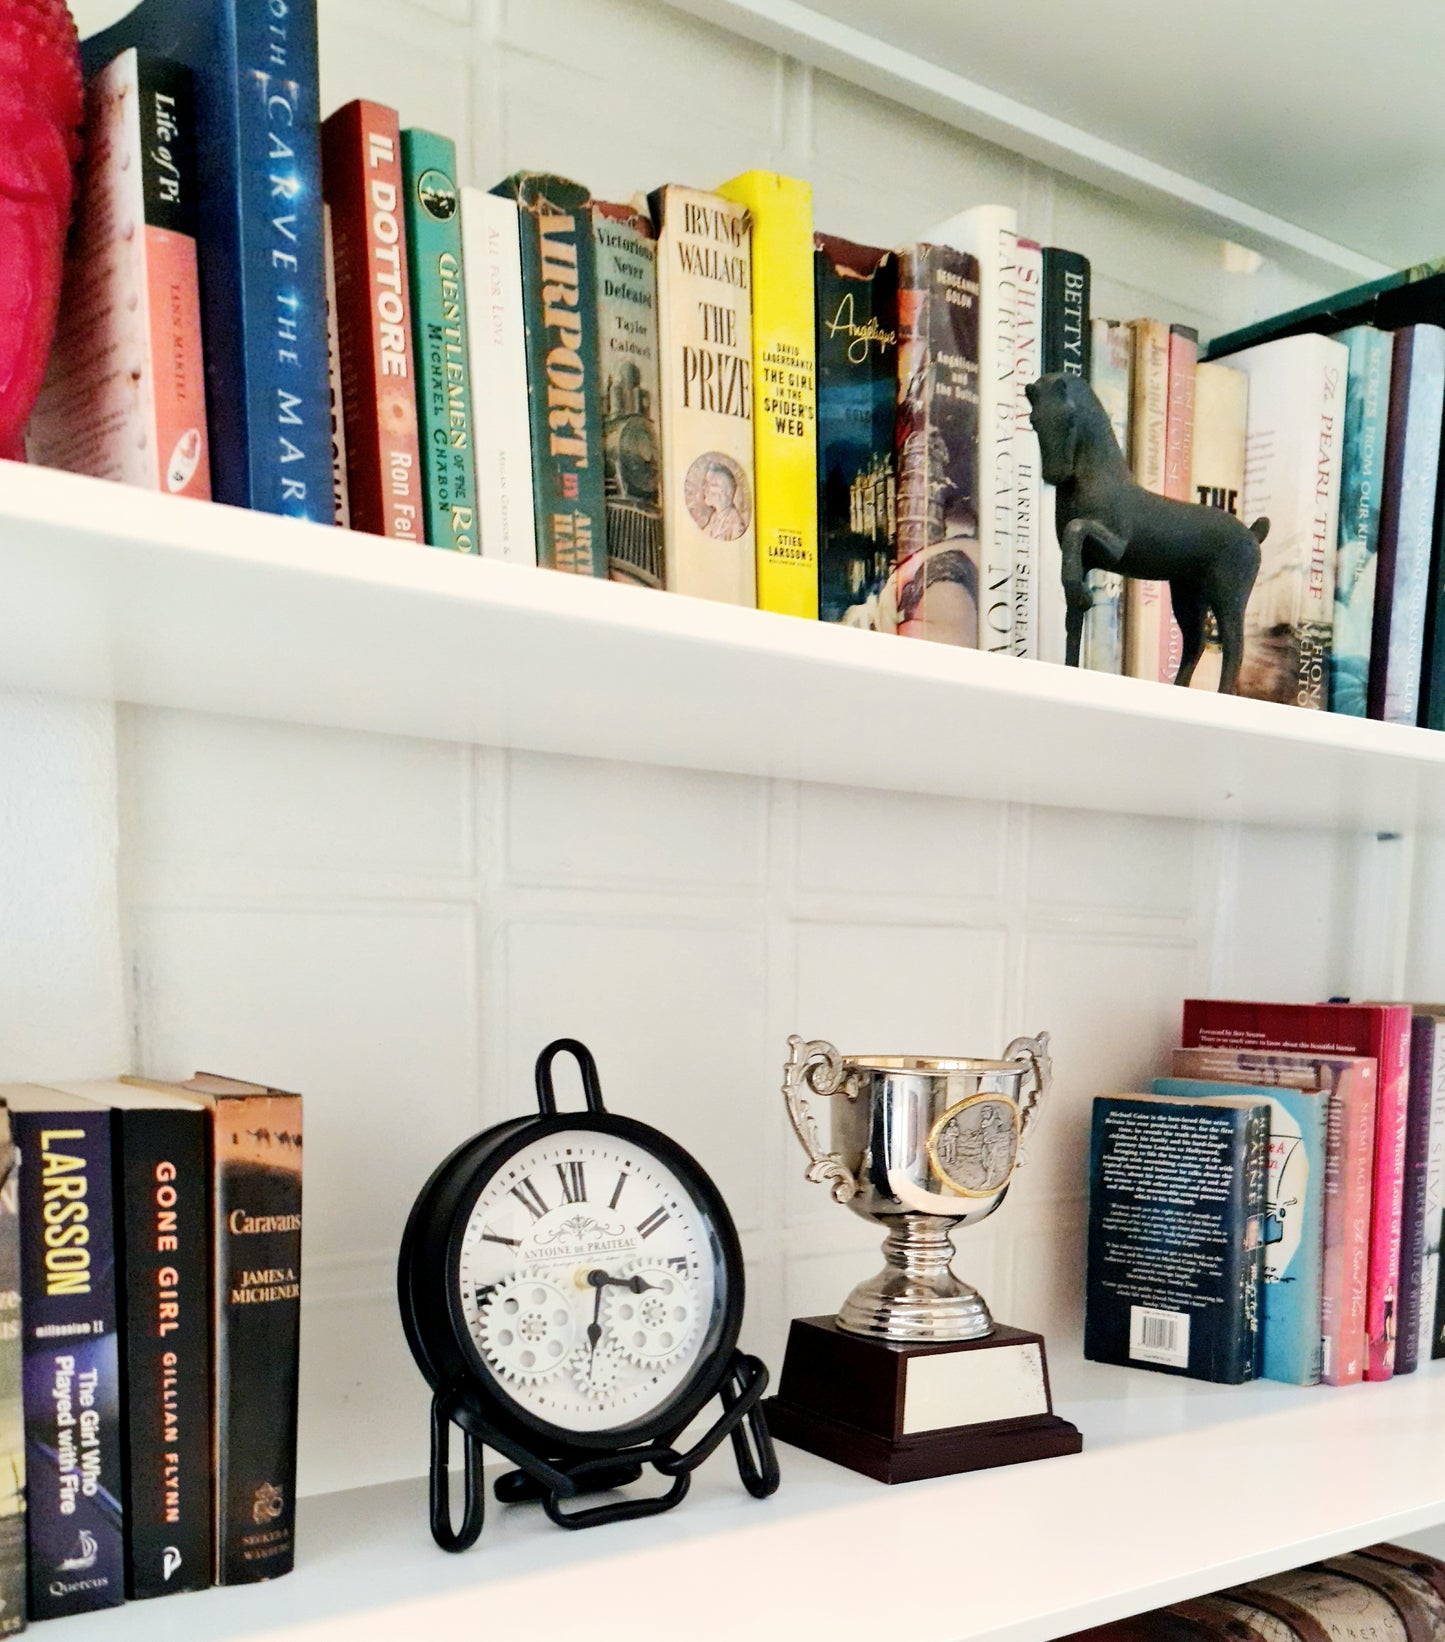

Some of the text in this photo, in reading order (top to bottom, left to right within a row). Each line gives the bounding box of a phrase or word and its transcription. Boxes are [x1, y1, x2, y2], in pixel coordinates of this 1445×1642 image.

[150, 91, 181, 206] Life of Pi
[684, 203, 742, 247] IRVING
[368, 132, 408, 379] IL DOTTORE
[613, 256, 644, 280] Never
[678, 241, 748, 290] WALLACE
[489, 265, 501, 297] FOR
[268, 95, 309, 520] CARVE THE MAR
[490, 303, 505, 347] LOVE
[615, 315, 648, 337] Taylor
[698, 302, 737, 348] THE
[826, 293, 897, 364] Angélique
[1062, 269, 1085, 357] BETTY
[438, 251, 468, 451] GENTLEMEN
[539, 195, 589, 468] AIRPORT
[776, 342, 800, 356] DAVID
[1014, 265, 1039, 432] SHANGHAI
[173, 335, 187, 402] MARTEL
[682, 346, 751, 420] PRIZE
[762, 353, 814, 372] LAGERCRANTZ
[763, 368, 815, 391] THE GIRL
[951, 373, 969, 386] and
[1365, 347, 1381, 418] SECRETS
[763, 397, 815, 420] SPIDER'S
[775, 387, 803, 401] IN THE
[993, 229, 1018, 545] LAUREN BACALL
[426, 322, 451, 513] MICHAEL CHABON
[774, 416, 805, 438] WEB
[389, 450, 412, 496] Ron
[452, 454, 465, 472] OF
[1362, 426, 1377, 476] FROM
[454, 472, 467, 500] THE
[1309, 364, 1340, 600] The PEARL THIEF
[1357, 480, 1372, 519] OUR
[1015, 464, 1032, 558] HARRIET
[777, 534, 803, 547] STIEG
[1161, 612, 1180, 679] oody
[1403, 671, 1416, 713] CLUB
[1357, 1102, 1369, 1152] NAOMI
[1395, 1110, 1408, 1124] A
[1393, 1129, 1406, 1175] Whole
[506, 1174, 552, 1226] XI
[552, 1160, 589, 1207] XII
[607, 1170, 631, 1211] I
[1391, 1178, 1403, 1217] Load
[1414, 1175, 1427, 1216] BLACK
[1426, 1143, 1442, 1216] SILVA
[40, 1128, 93, 1297] LARSSON
[228, 1208, 301, 1235] Caravans
[636, 1203, 672, 1240] II
[1390, 1218, 1401, 1234] of
[154, 1160, 180, 1339] GONE GIRL
[523, 1245, 572, 1260] ANTOINE
[1388, 1236, 1401, 1277] Front
[1411, 1218, 1425, 1267] DAHLIA
[230, 1283, 300, 1304] MICHENER
[240, 1268, 286, 1288] JAMES
[1407, 1288, 1420, 1330] WHITE
[1405, 1333, 1417, 1365] ROSE
[52, 1354, 79, 1517] Played with Fire
[78, 1366, 102, 1498] The Girl Who
[162, 1350, 181, 1525] GILLIAN FLYNN
[49, 1576, 110, 1597] Quercus
